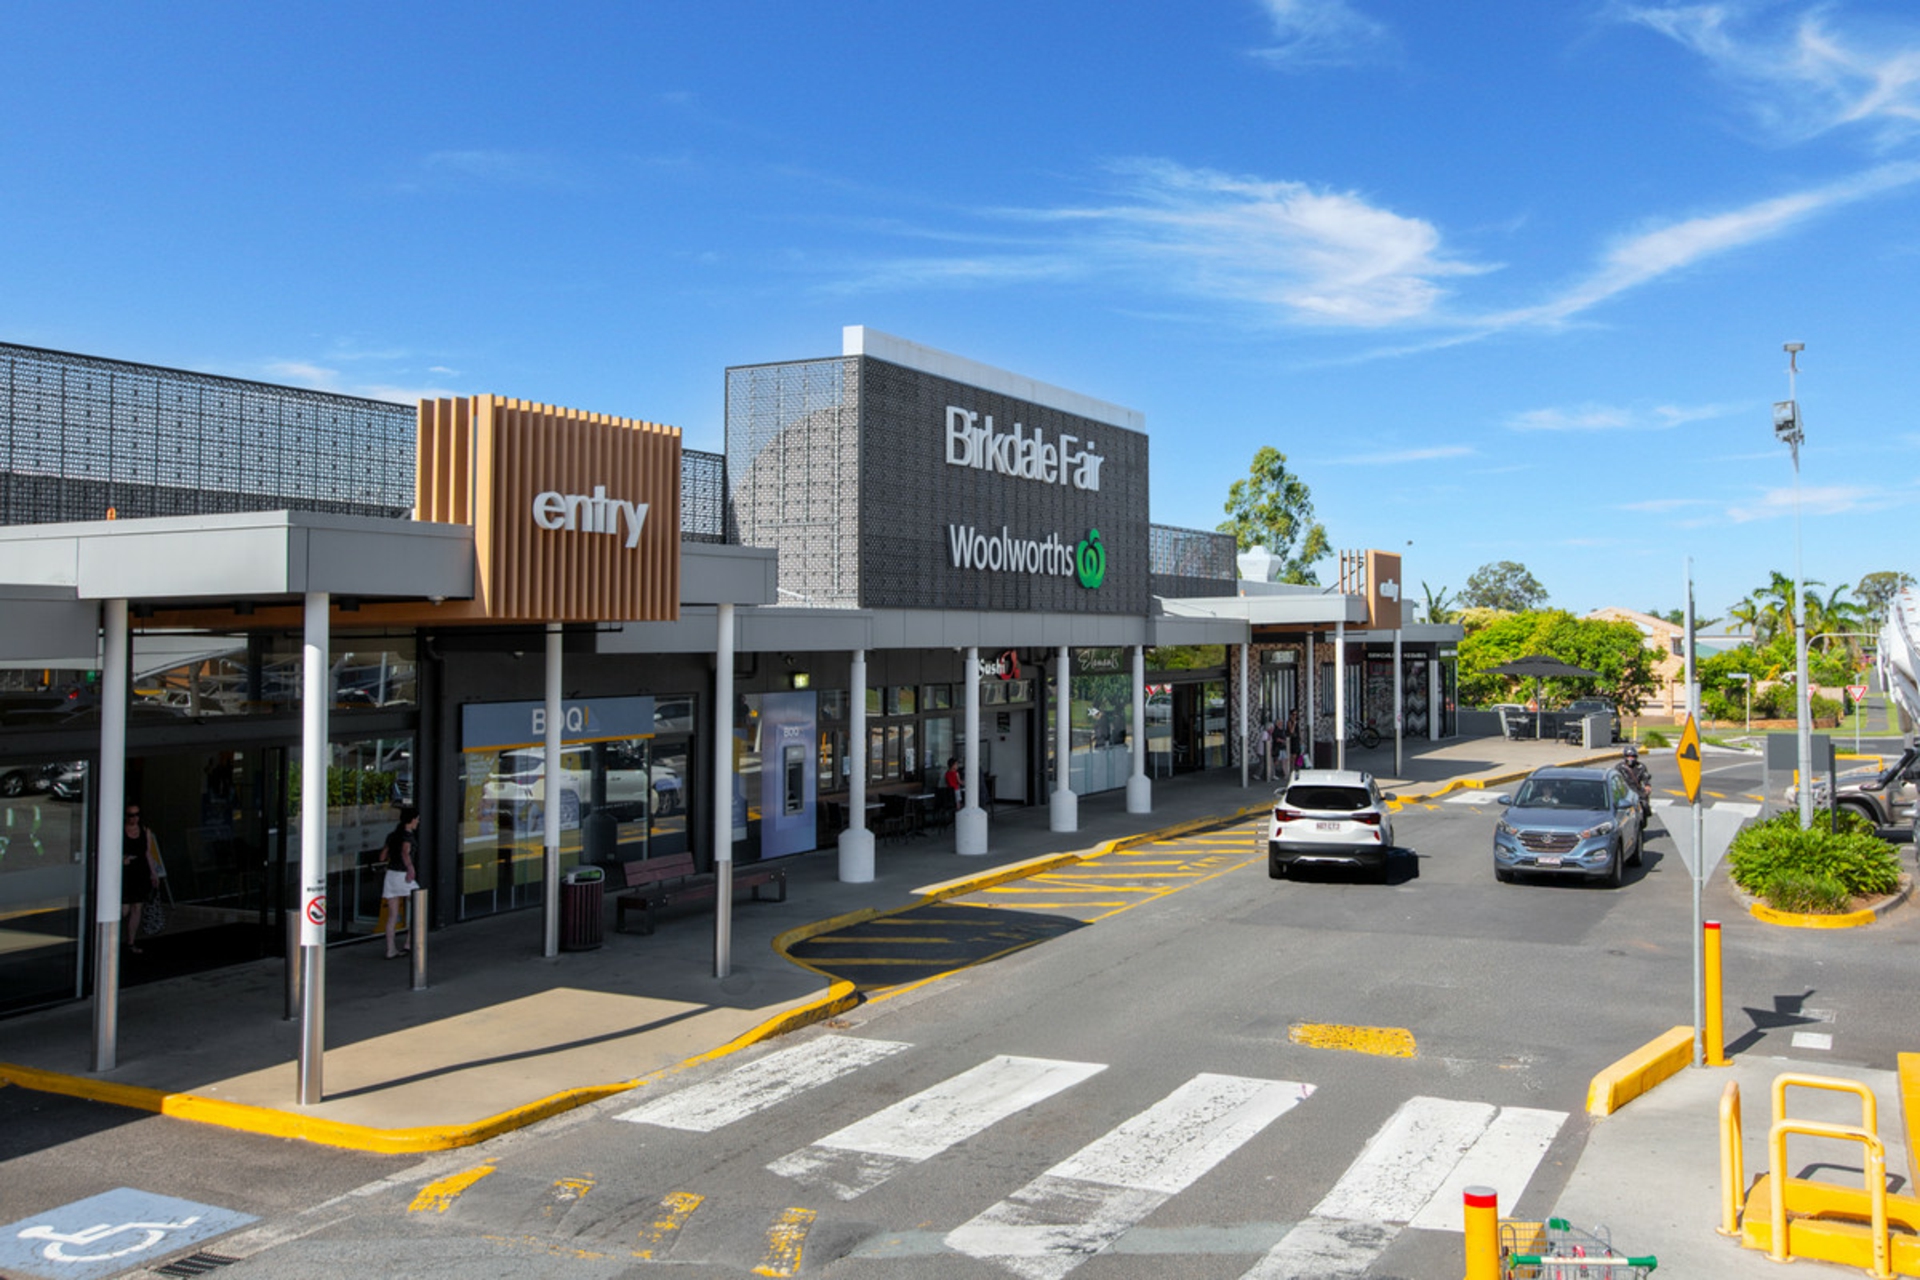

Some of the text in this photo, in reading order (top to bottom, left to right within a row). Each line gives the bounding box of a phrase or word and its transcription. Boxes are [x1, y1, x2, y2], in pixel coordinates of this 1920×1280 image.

[946, 405, 1105, 491] Birkdale Fair
[533, 485, 649, 548] entry
[950, 524, 1074, 577] Woolworths
[978, 657, 1005, 679] Sushi
